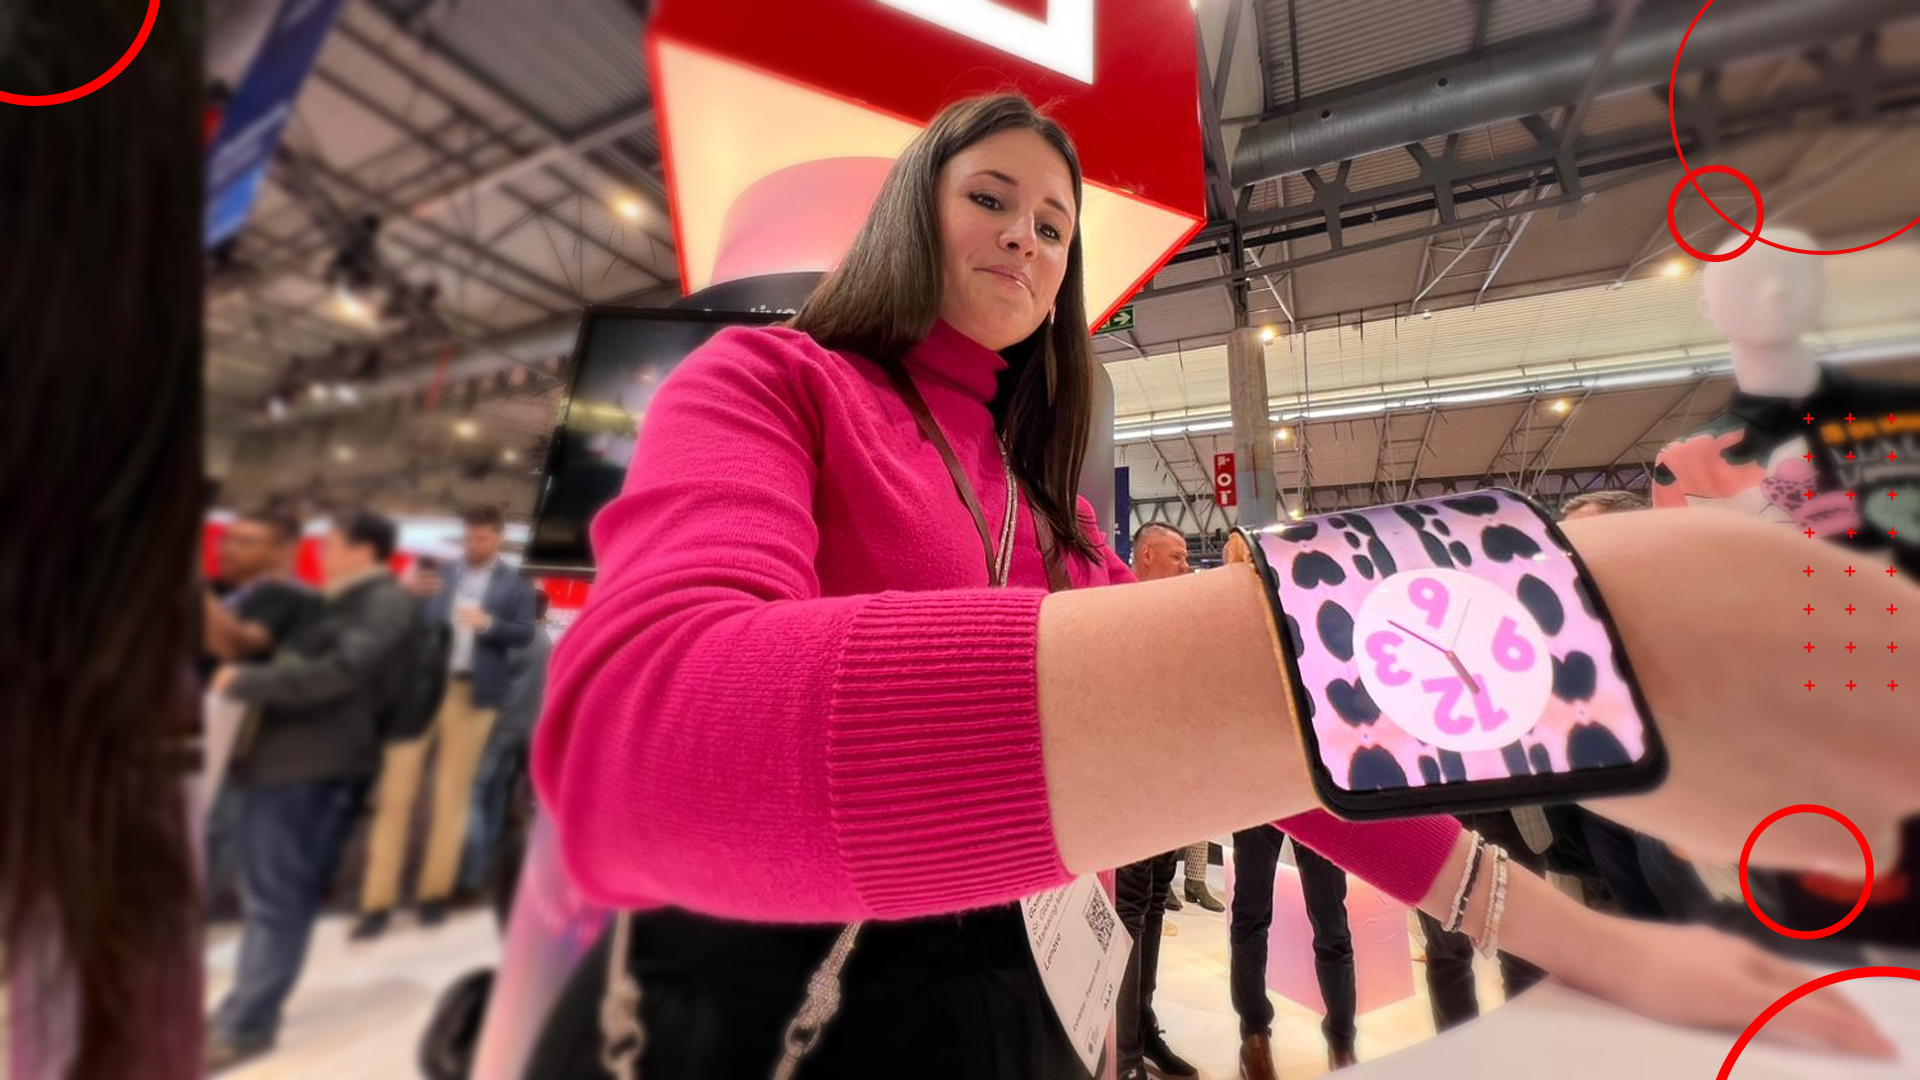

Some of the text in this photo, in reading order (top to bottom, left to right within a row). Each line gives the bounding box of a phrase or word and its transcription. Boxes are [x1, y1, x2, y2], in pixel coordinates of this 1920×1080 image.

[1364, 630, 1413, 687] 3
[1421, 673, 1509, 736] 12
[1043, 931, 1062, 972] Lenovo
